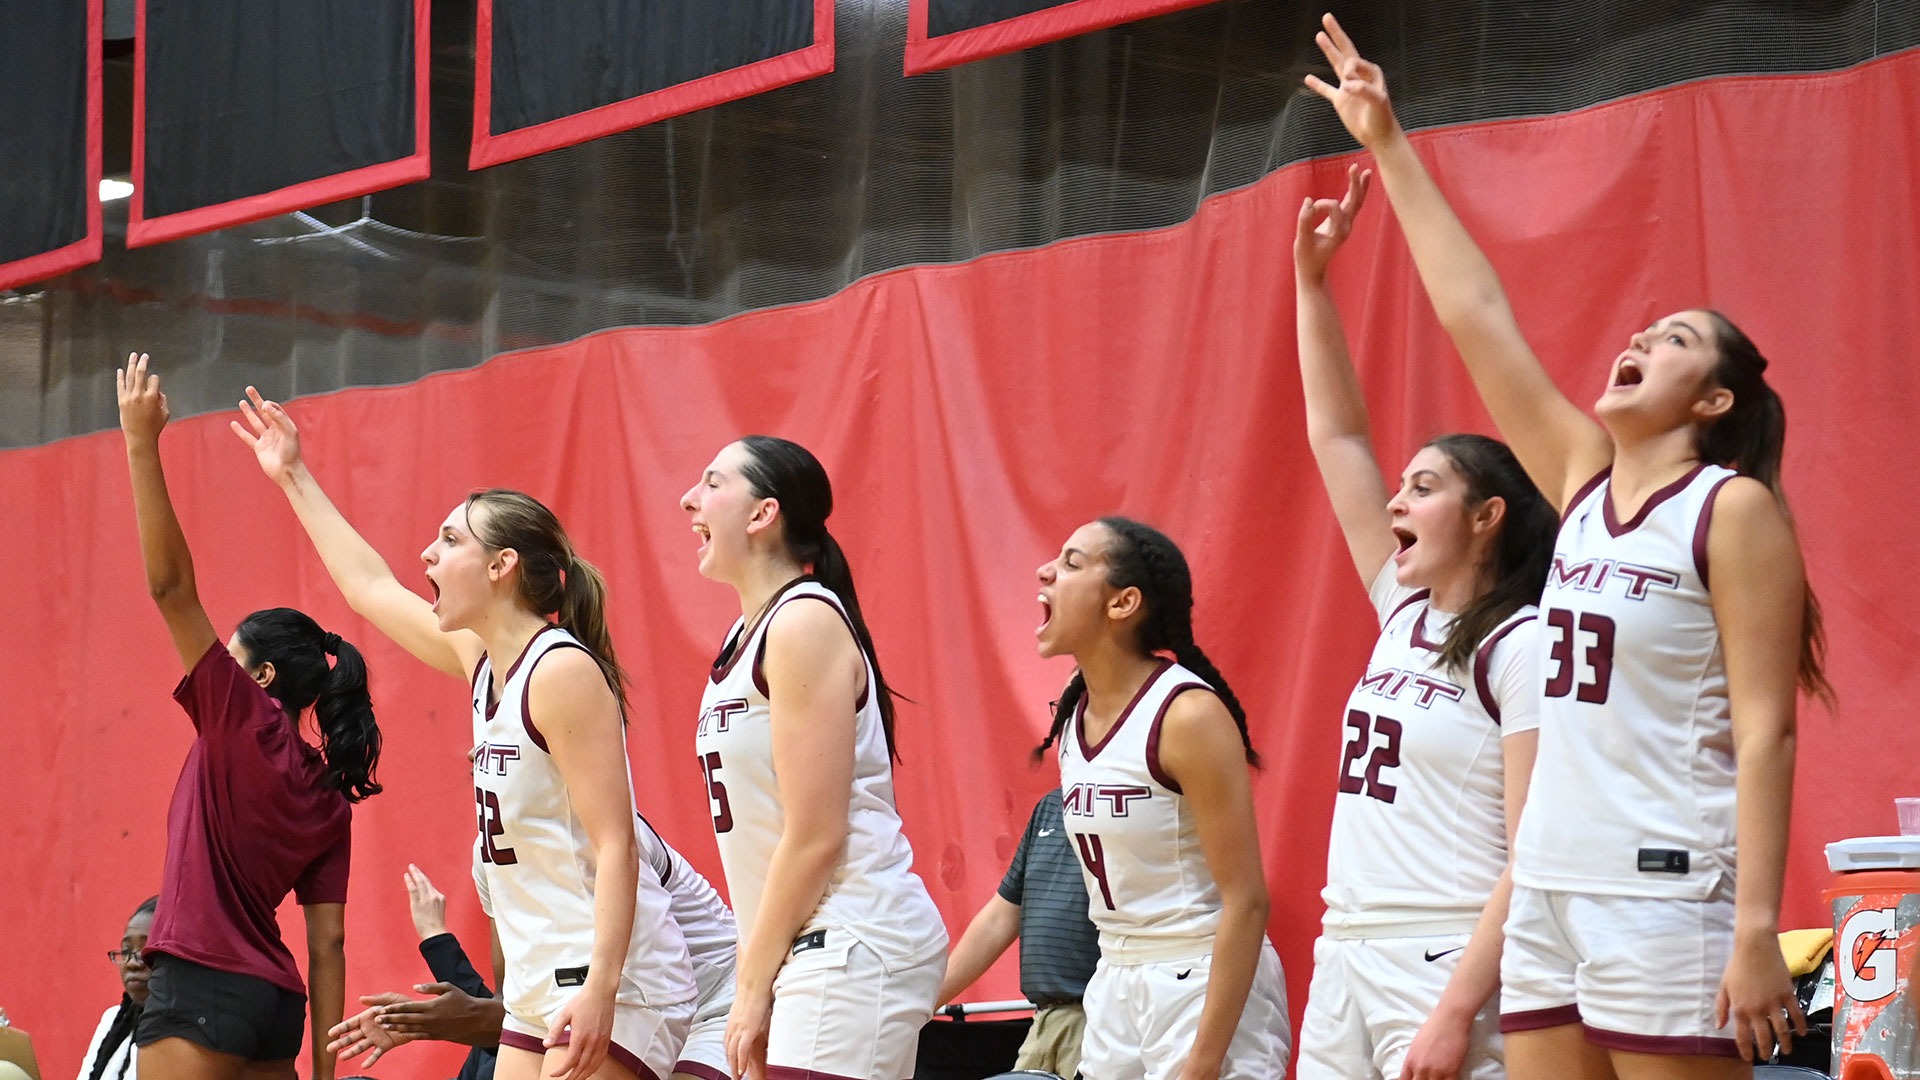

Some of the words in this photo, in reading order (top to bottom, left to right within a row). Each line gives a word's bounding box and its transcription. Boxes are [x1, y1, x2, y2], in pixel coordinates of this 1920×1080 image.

[1545, 552, 1680, 601] MIT
[1544, 607, 1616, 705] 33
[698, 751, 734, 834] 5
[1339, 708, 1403, 804] 22
[1075, 833, 1117, 911] 4
[1839, 907, 1897, 1002] G
